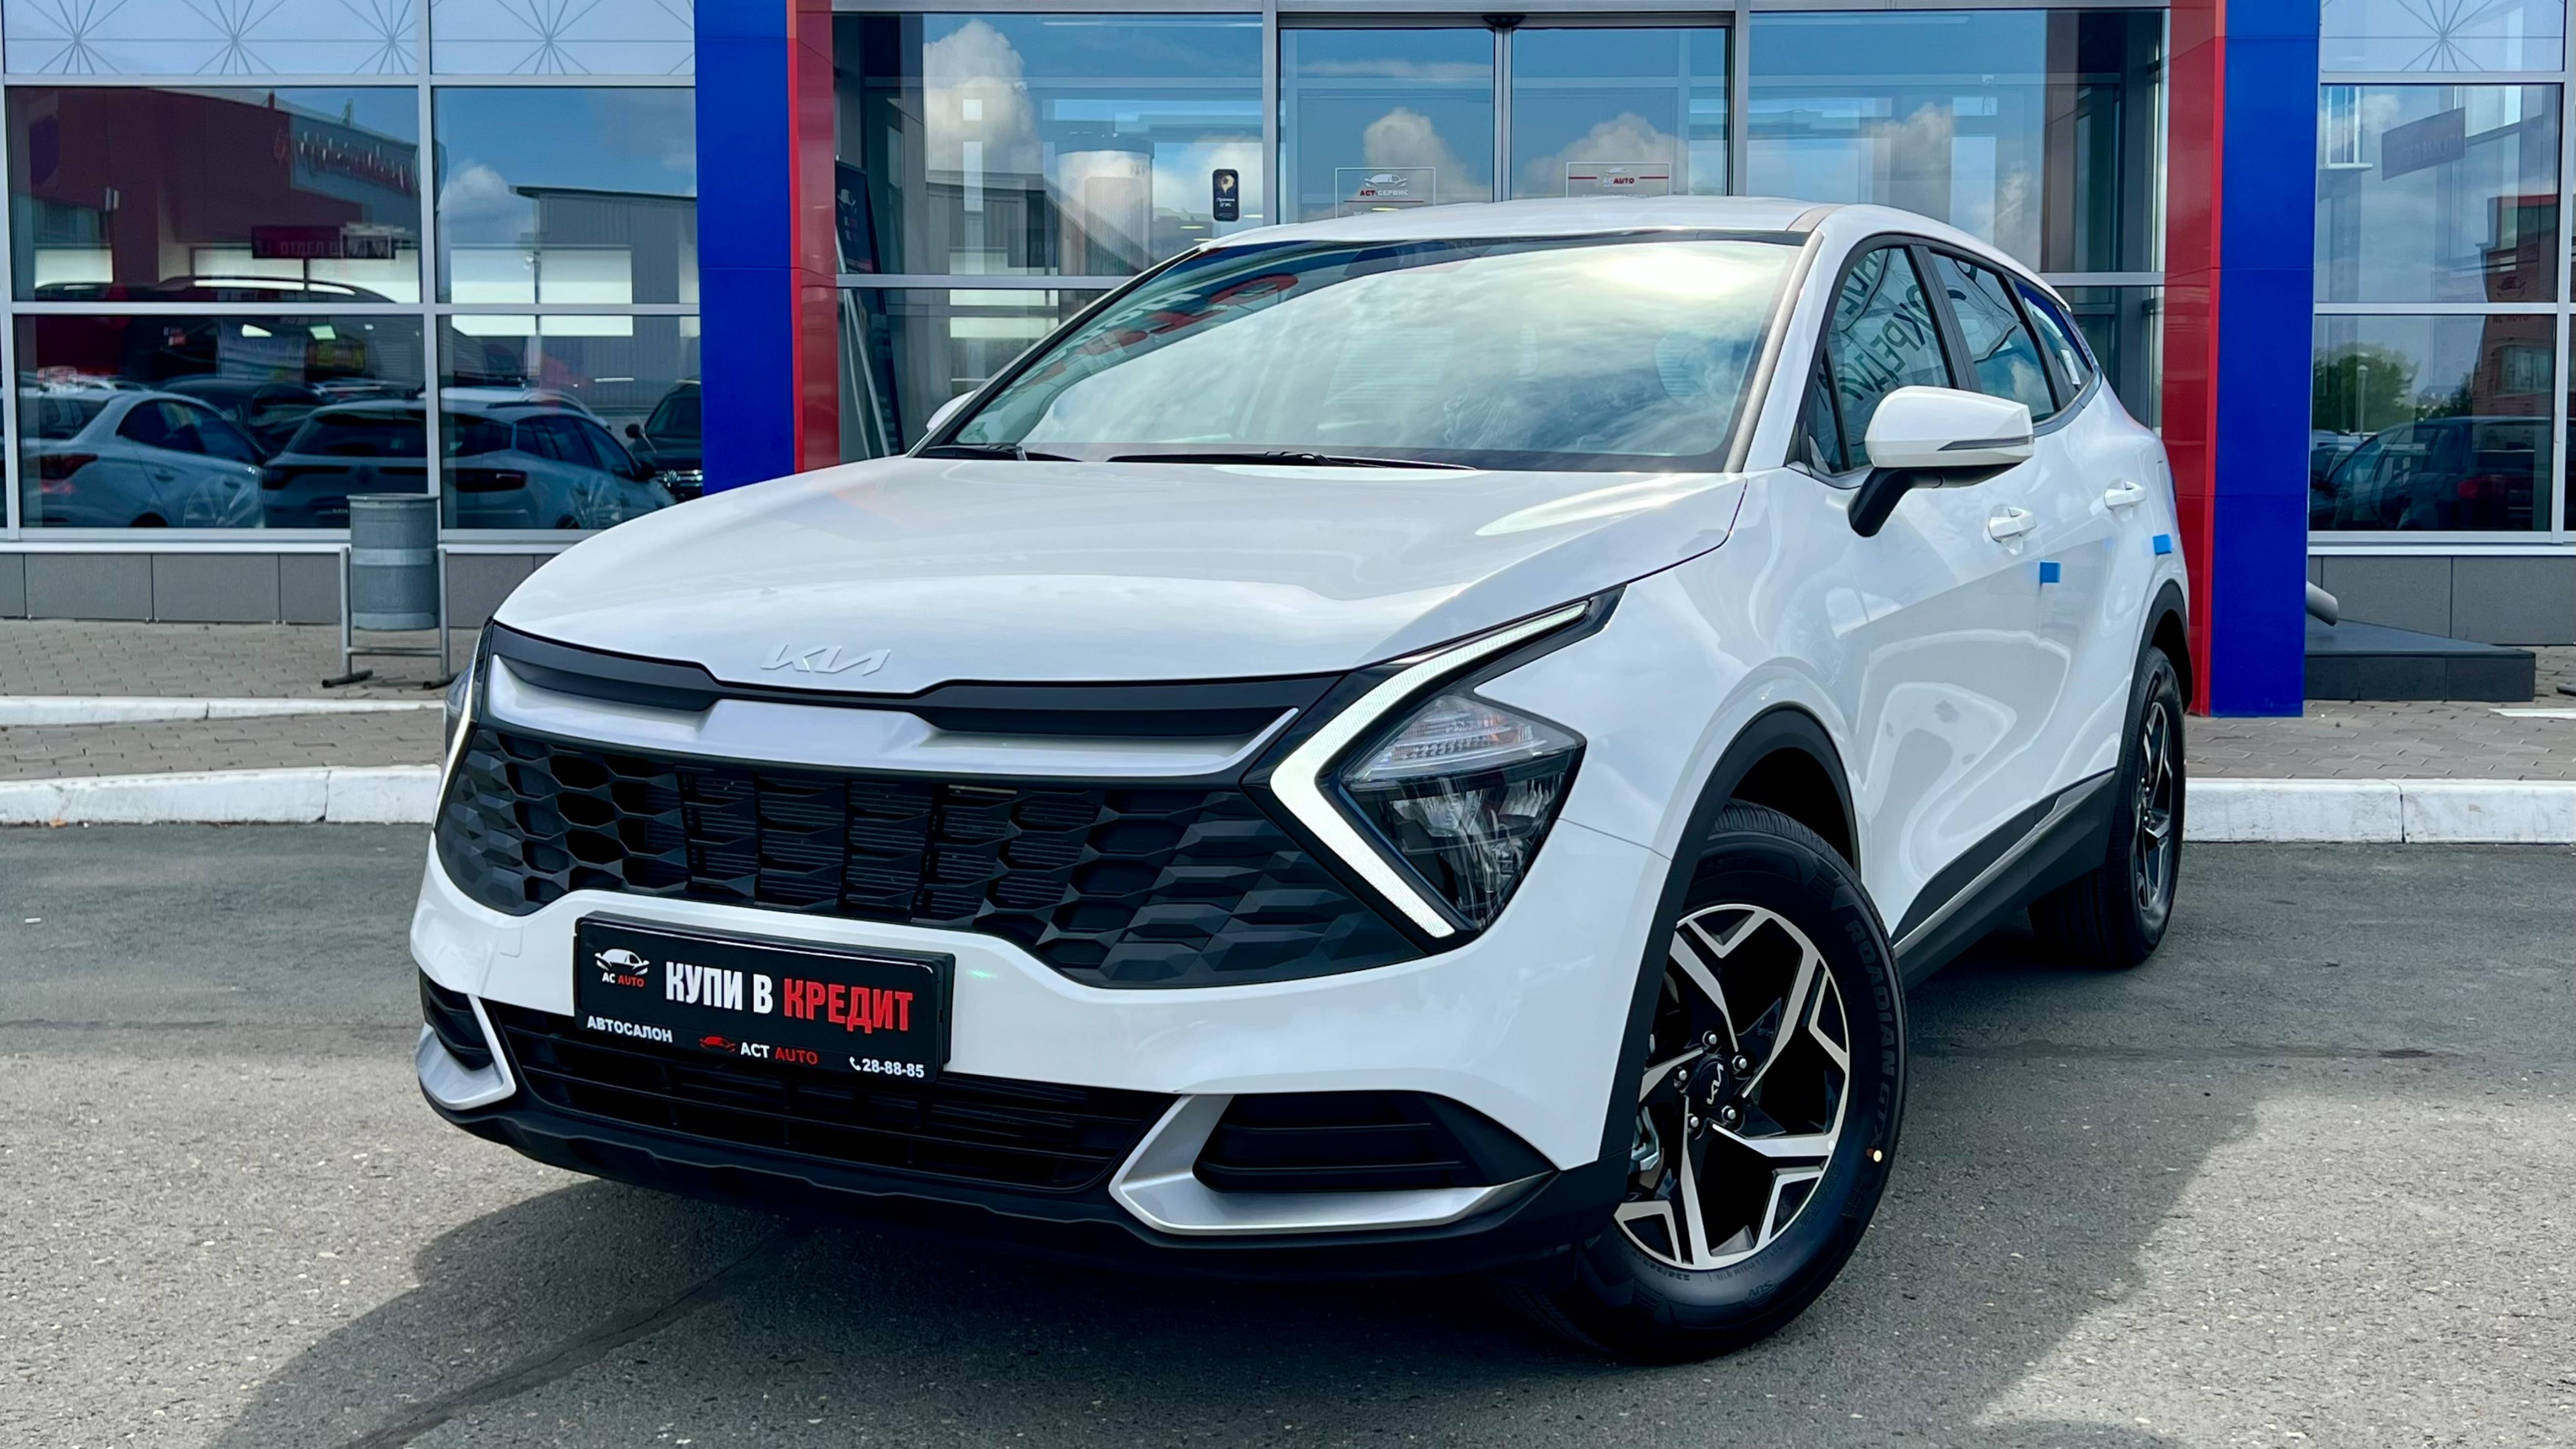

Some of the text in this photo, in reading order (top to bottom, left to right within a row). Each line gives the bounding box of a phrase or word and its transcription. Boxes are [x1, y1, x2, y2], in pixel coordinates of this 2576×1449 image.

[760, 643, 891, 677] KIA
[602, 972, 645, 987] AC AUTO
[666, 961, 913, 1034] КУПИ В КРЕДИТ
[1845, 919, 1895, 1077] ROADIAN
[586, 1015, 674, 1043] АВТОСАЛОН
[774, 1046, 818, 1065] AUTO
[861, 1058, 925, 1079] 28-88-85
